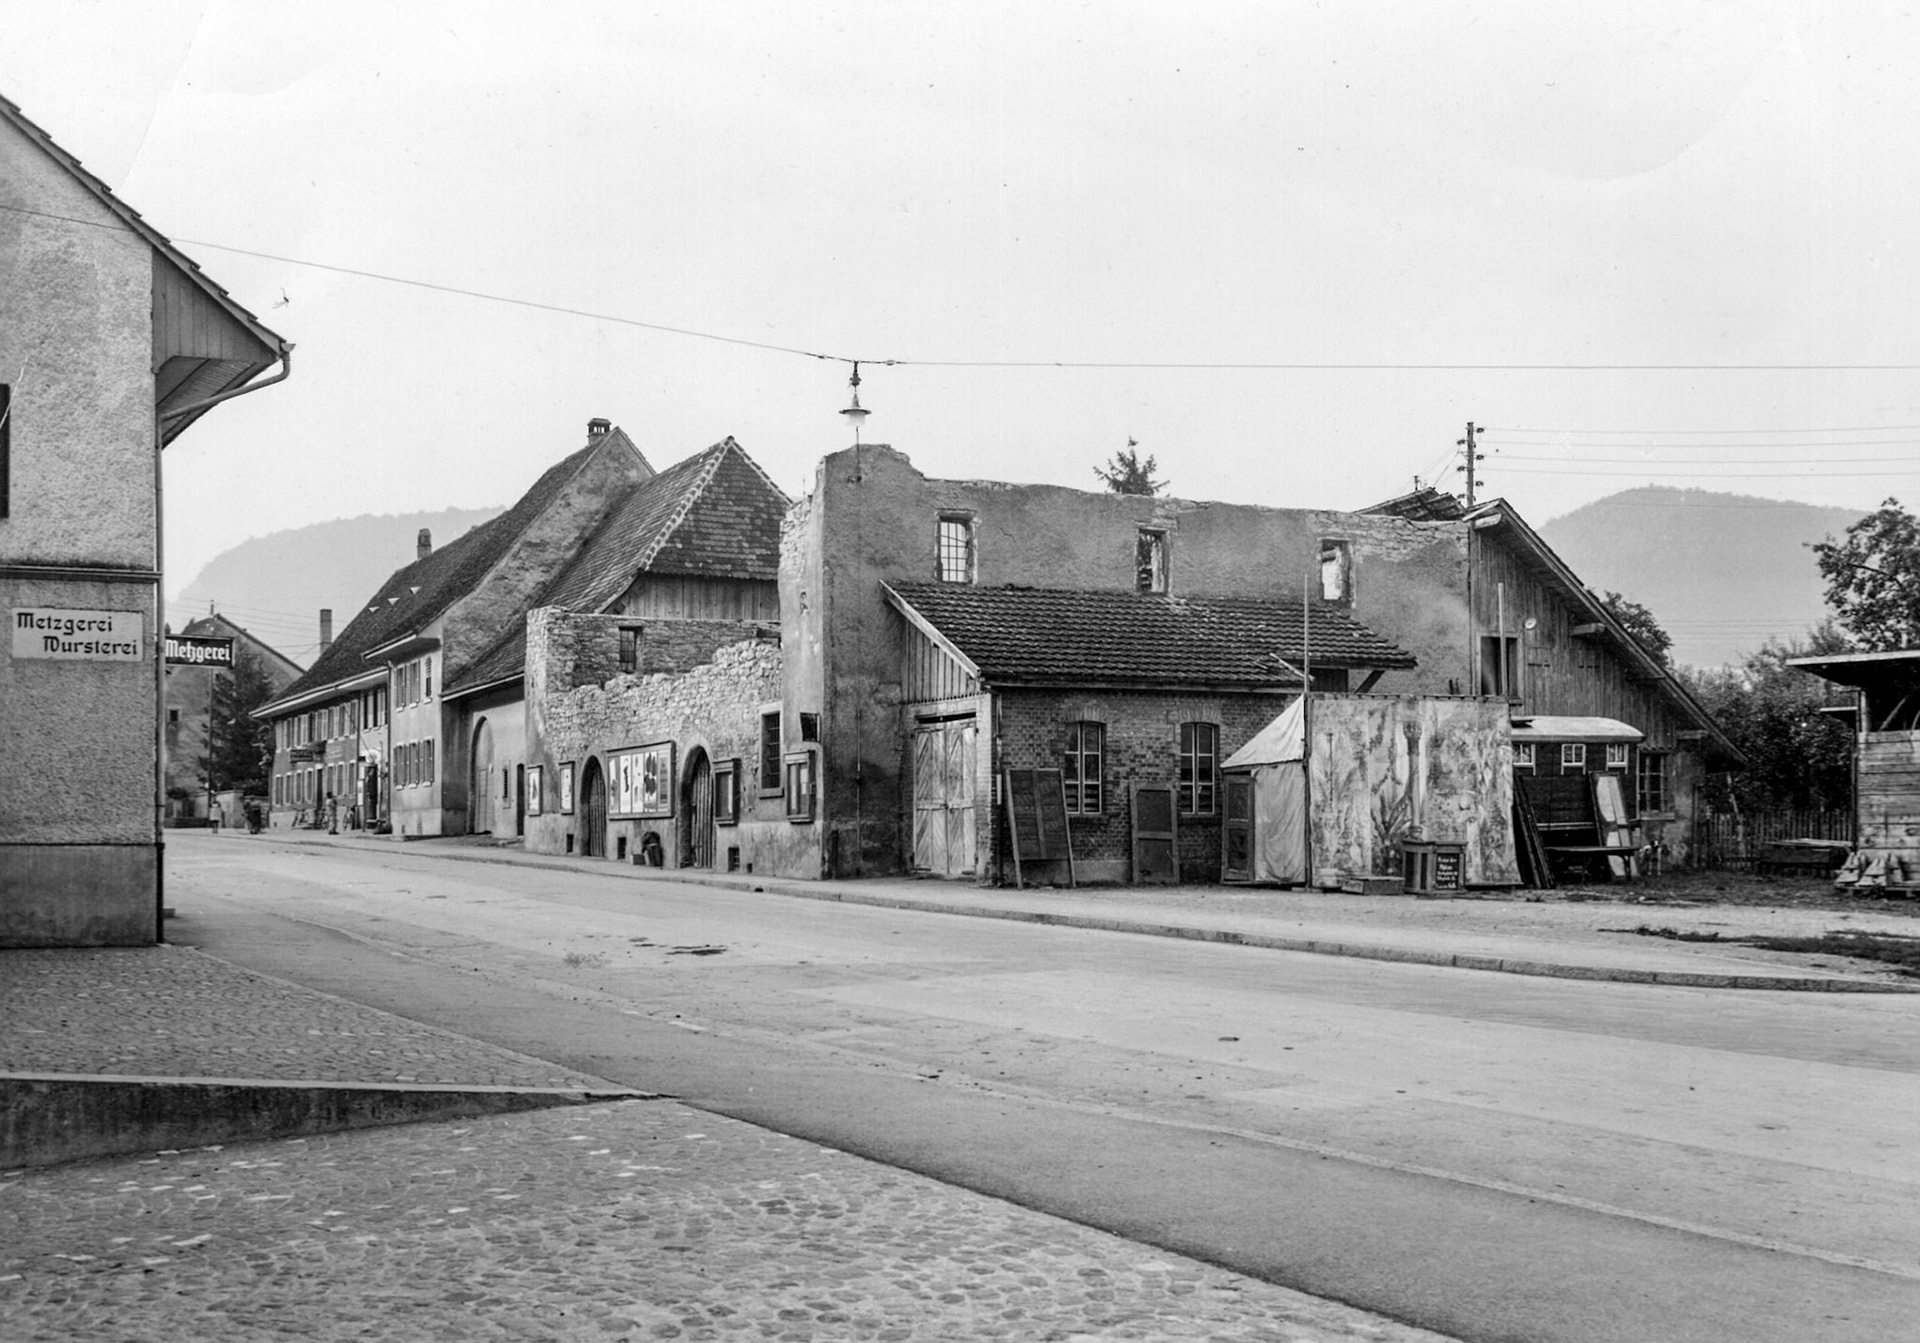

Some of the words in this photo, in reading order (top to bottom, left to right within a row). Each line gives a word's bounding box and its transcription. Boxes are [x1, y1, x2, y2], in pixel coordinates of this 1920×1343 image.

[17, 611, 113, 636] Metzgerei
[42, 635, 138, 656] Wursterei
[165, 639, 231, 663] Metzgerei
